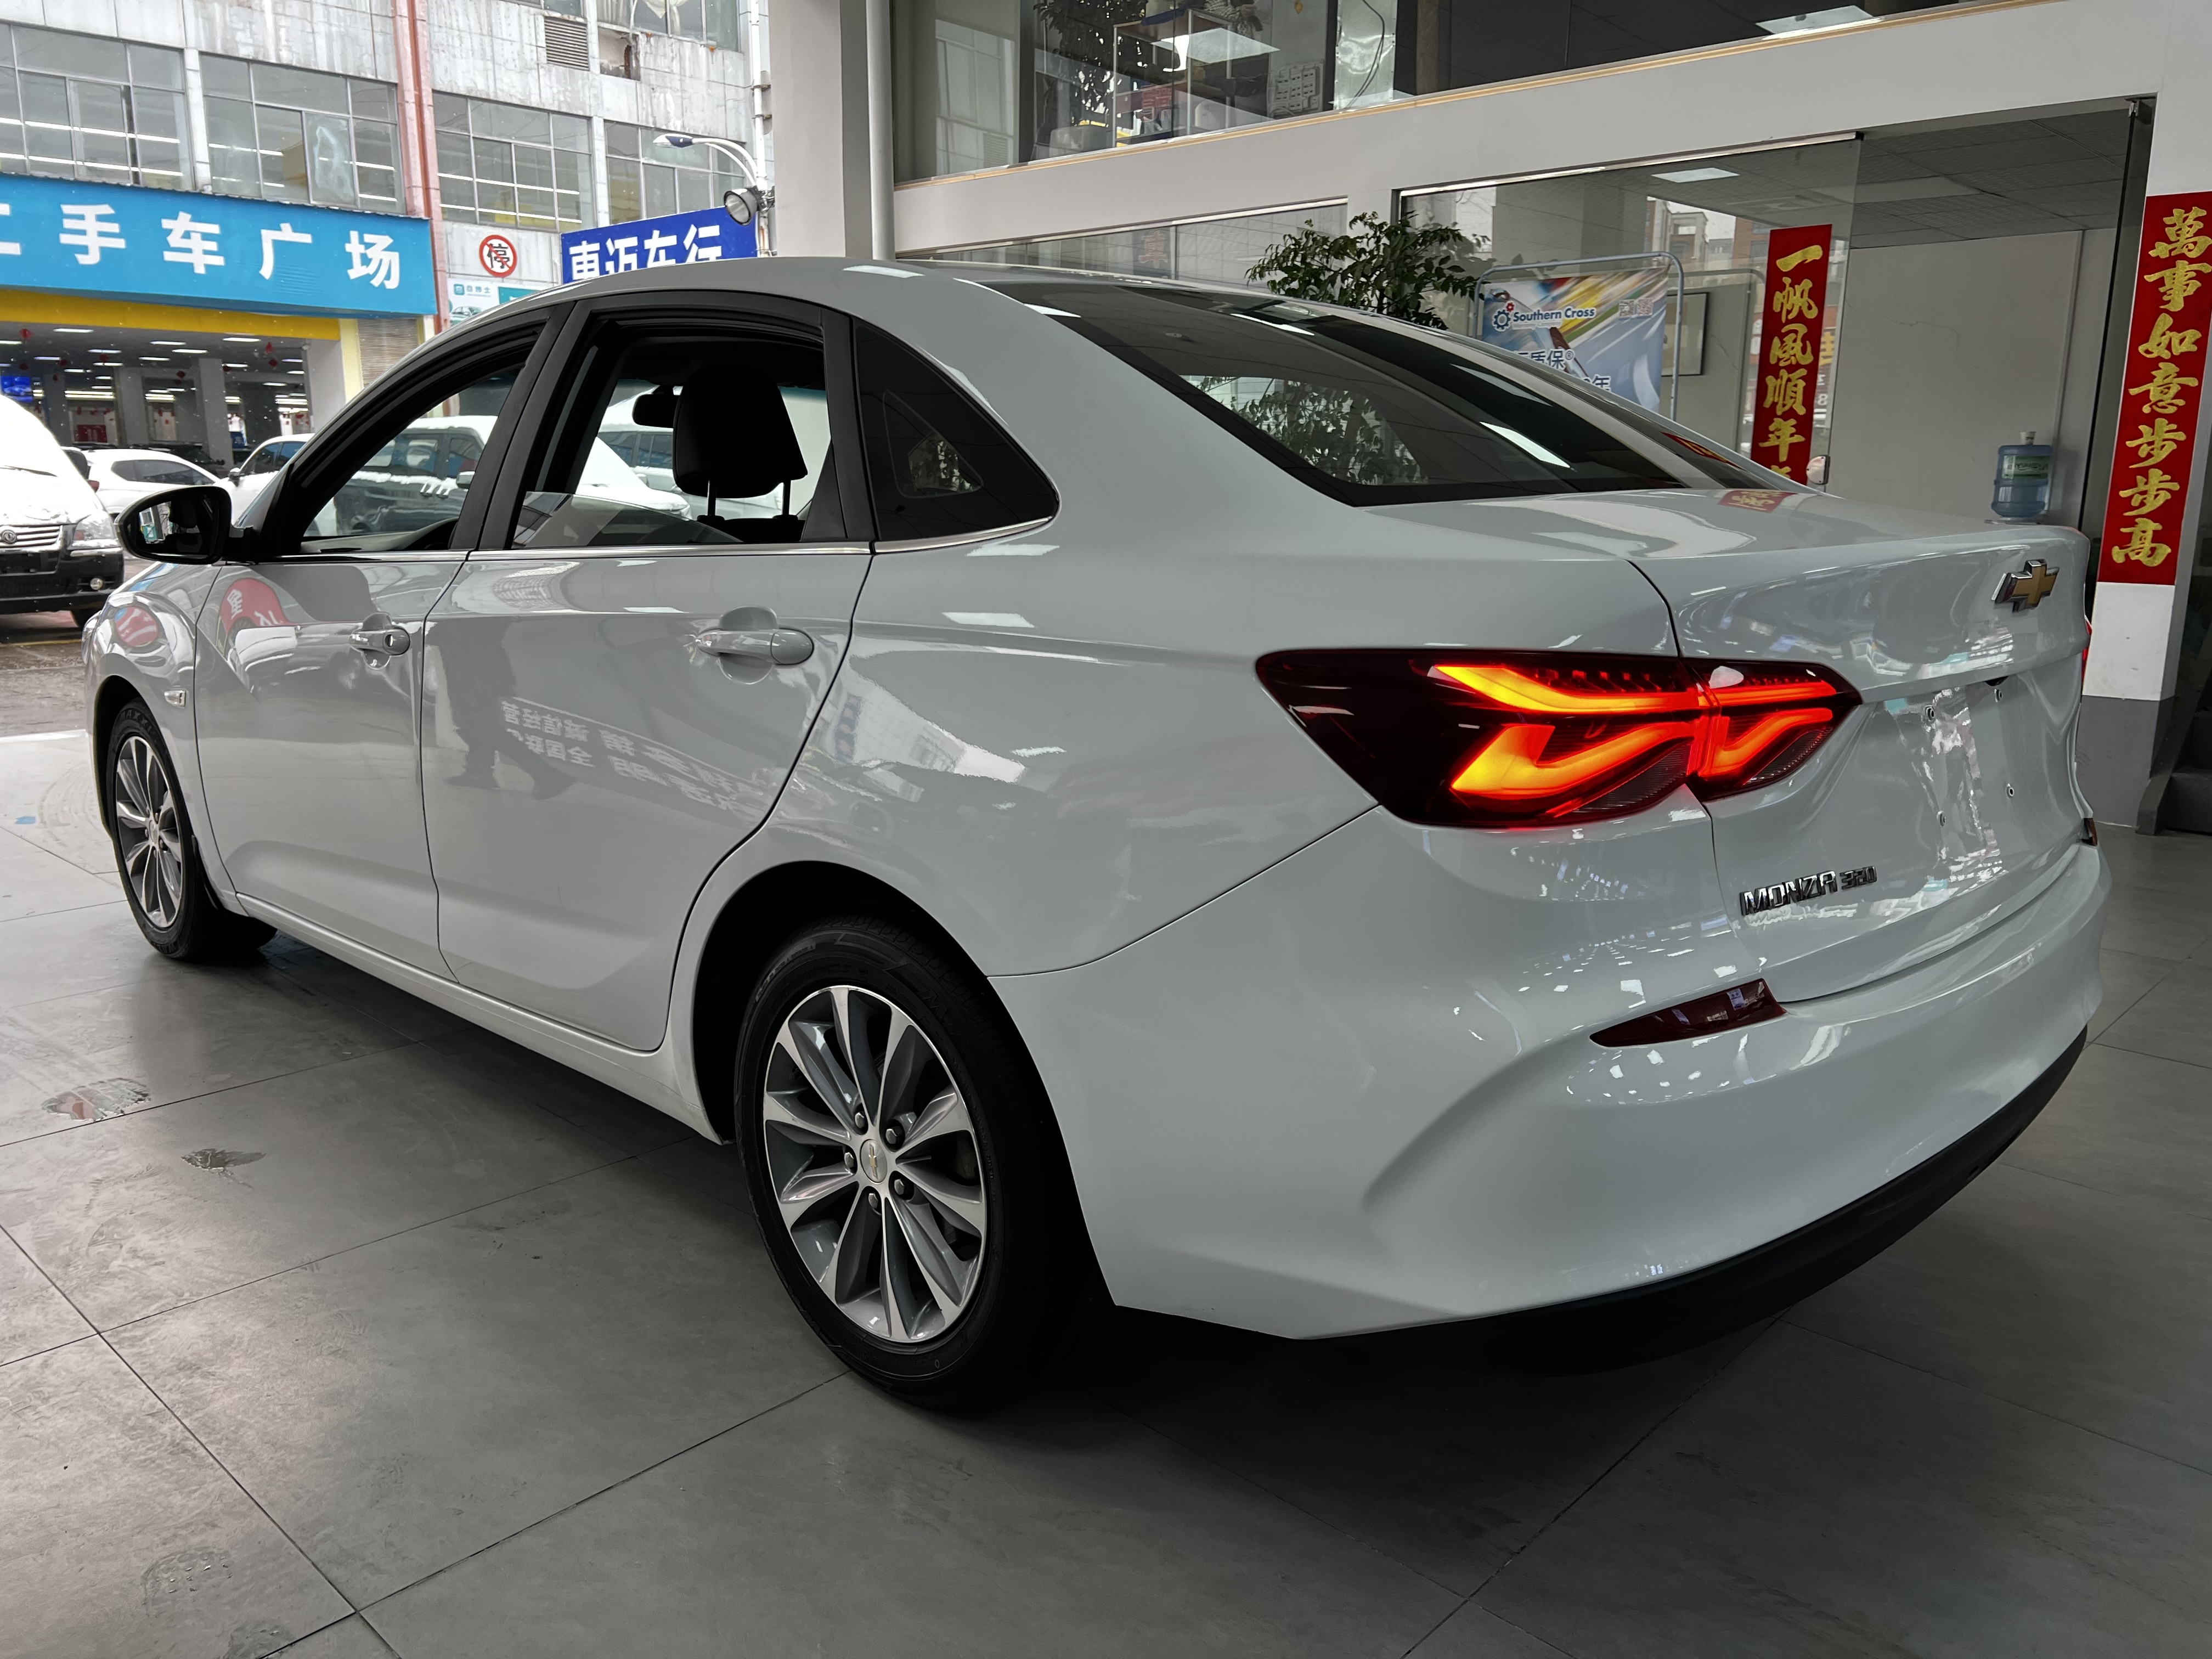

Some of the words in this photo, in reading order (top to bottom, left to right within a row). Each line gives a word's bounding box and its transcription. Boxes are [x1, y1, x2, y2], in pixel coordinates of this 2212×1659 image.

[487, 243, 509, 269] 停
[1513, 310, 1562, 322] Southern
[1565, 307, 1595, 318] Cross
[1583, 376, 1610, 391] 年
[1740, 870, 1838, 916] MONZA
[1839, 866, 1877, 890] 320
